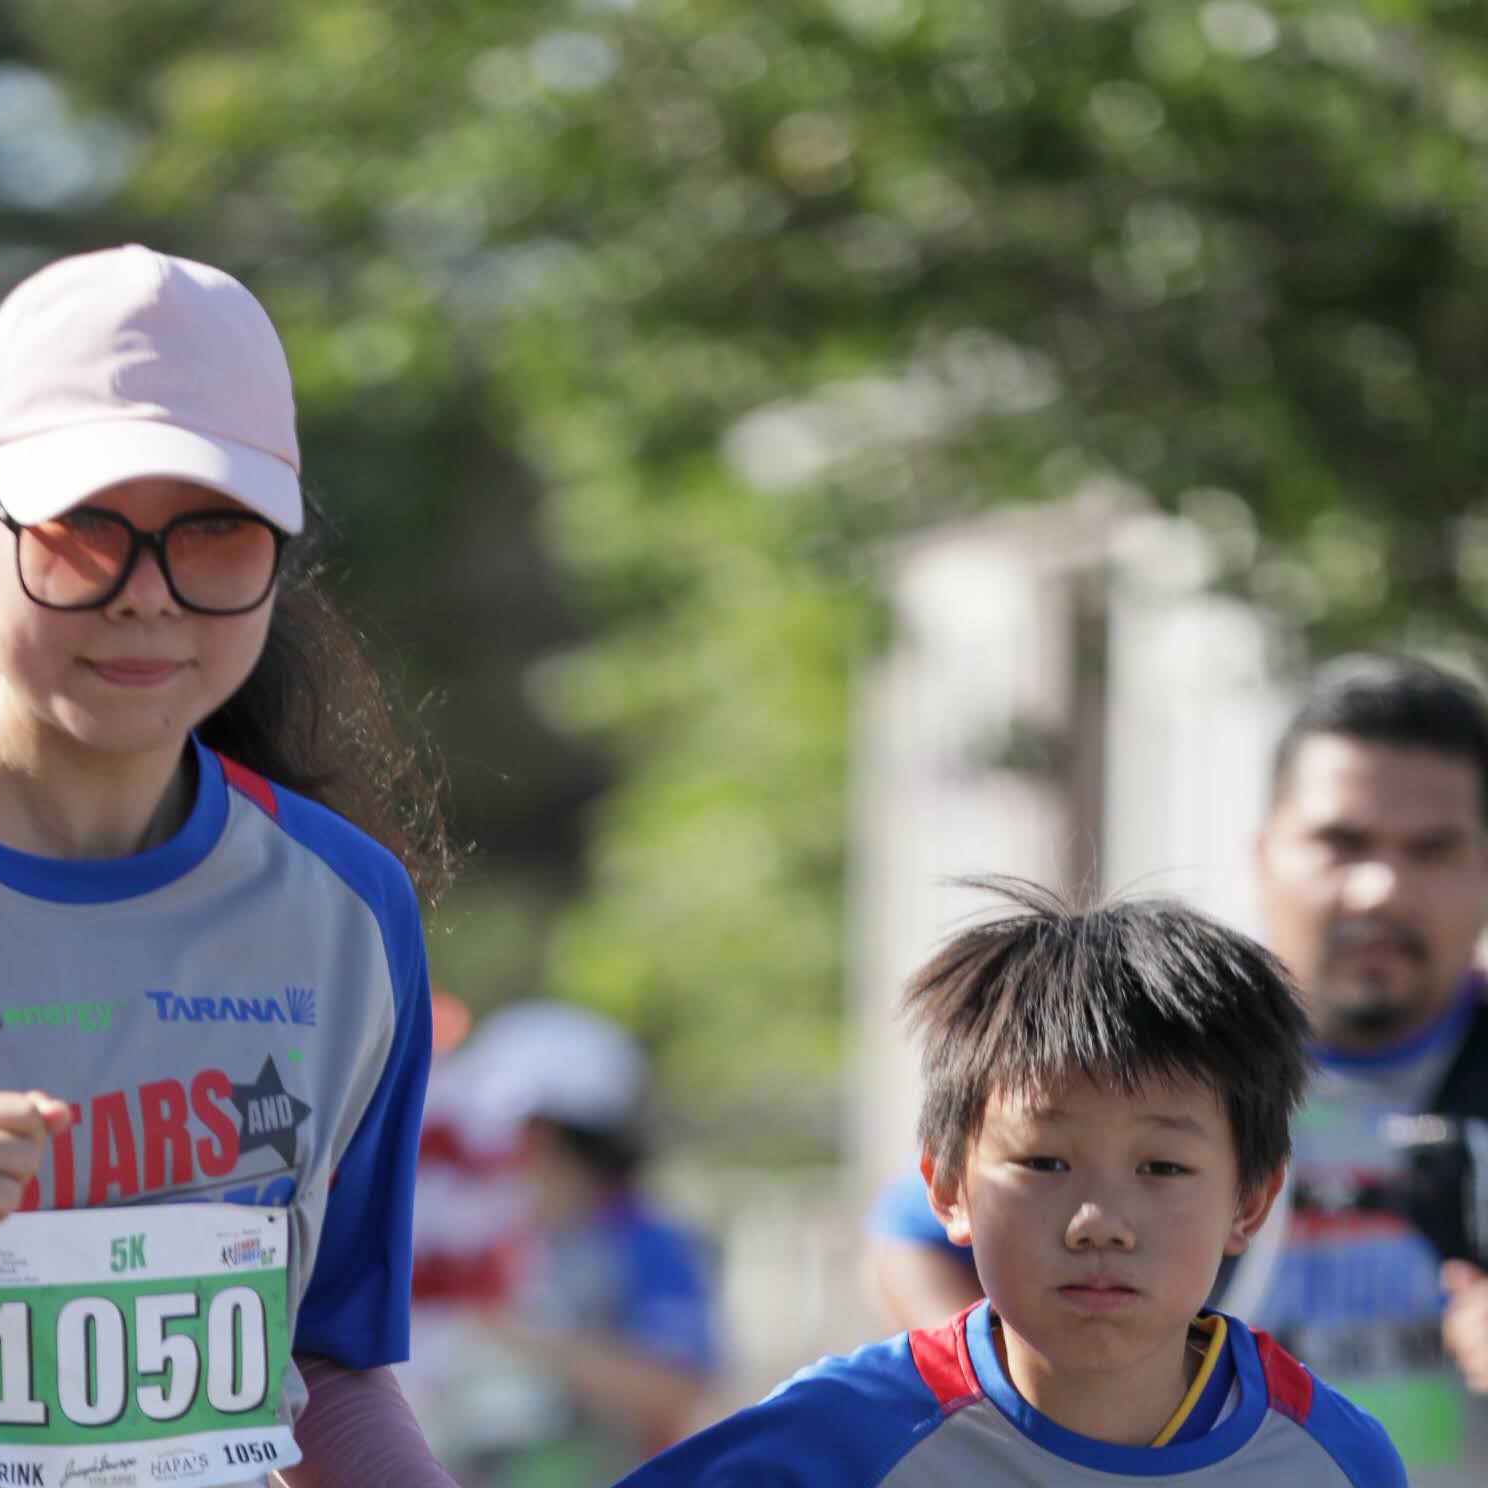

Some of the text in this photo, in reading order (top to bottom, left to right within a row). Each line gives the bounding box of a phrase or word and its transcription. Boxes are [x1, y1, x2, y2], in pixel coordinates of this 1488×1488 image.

[144, 990, 284, 1025] TARANA
[247, 1092, 293, 1136] AND
[17, 1068, 240, 1211] TARS
[110, 1233, 147, 1273] 5K
[223, 1441, 279, 1465] 1050
